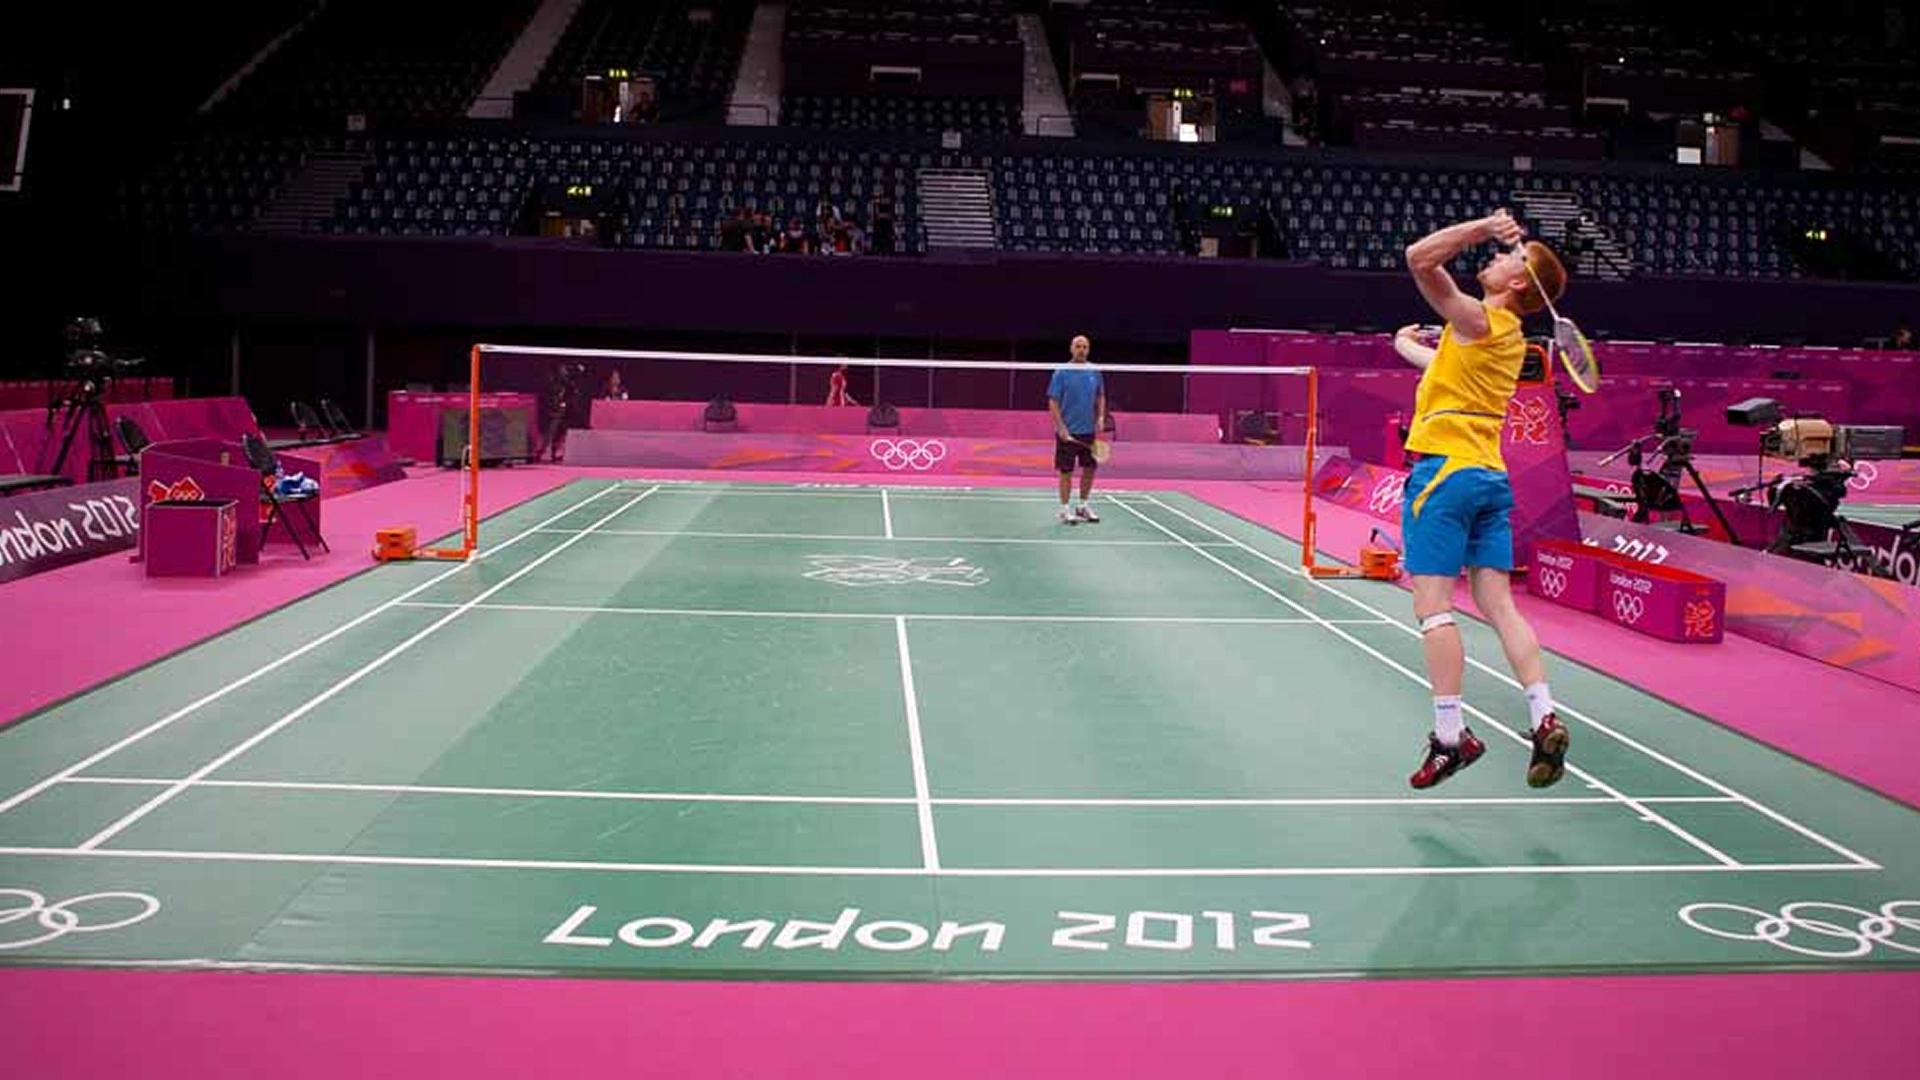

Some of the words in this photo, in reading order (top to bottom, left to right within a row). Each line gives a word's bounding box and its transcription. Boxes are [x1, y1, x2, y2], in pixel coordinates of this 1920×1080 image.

[68, 494, 140, 541] 2012
[543, 905, 1007, 952] London
[1051, 909, 1313, 951] 2012
